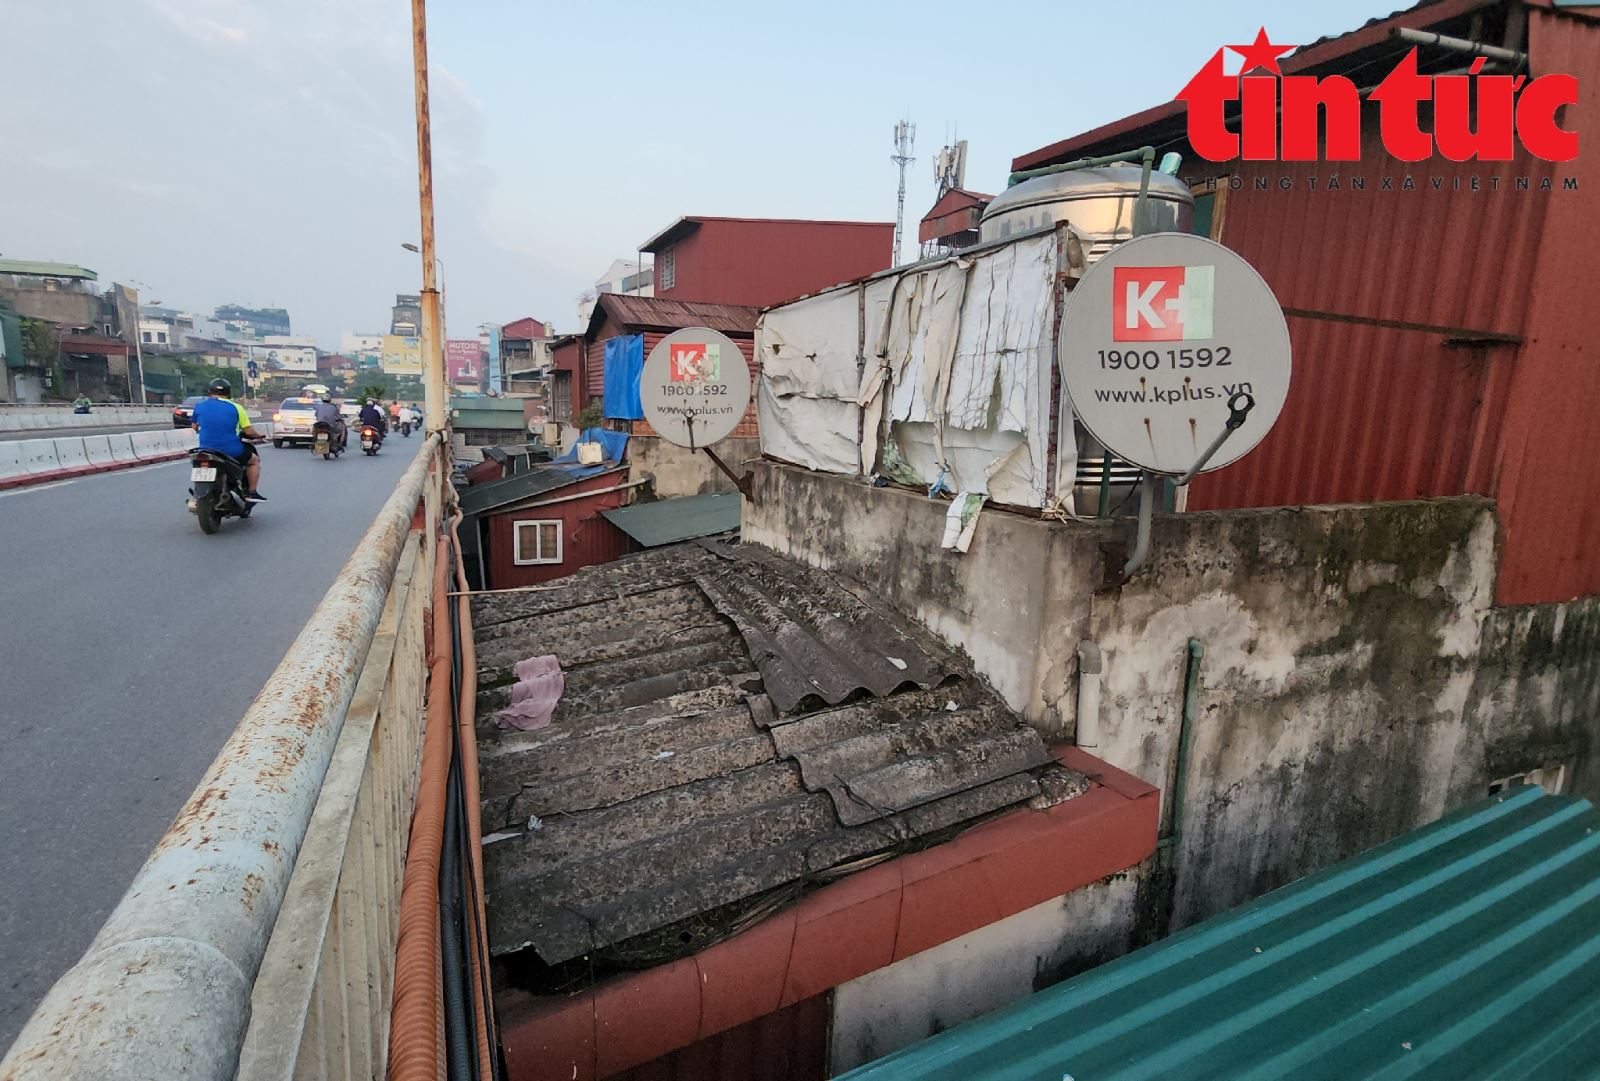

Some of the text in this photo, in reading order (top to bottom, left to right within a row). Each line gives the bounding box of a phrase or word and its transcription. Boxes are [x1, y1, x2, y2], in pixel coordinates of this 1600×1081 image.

[1098, 346, 1232, 370] 1900 1592
[661, 384, 727, 396] 1900 592
[1094, 382, 1253, 405] www.kplus.vn
